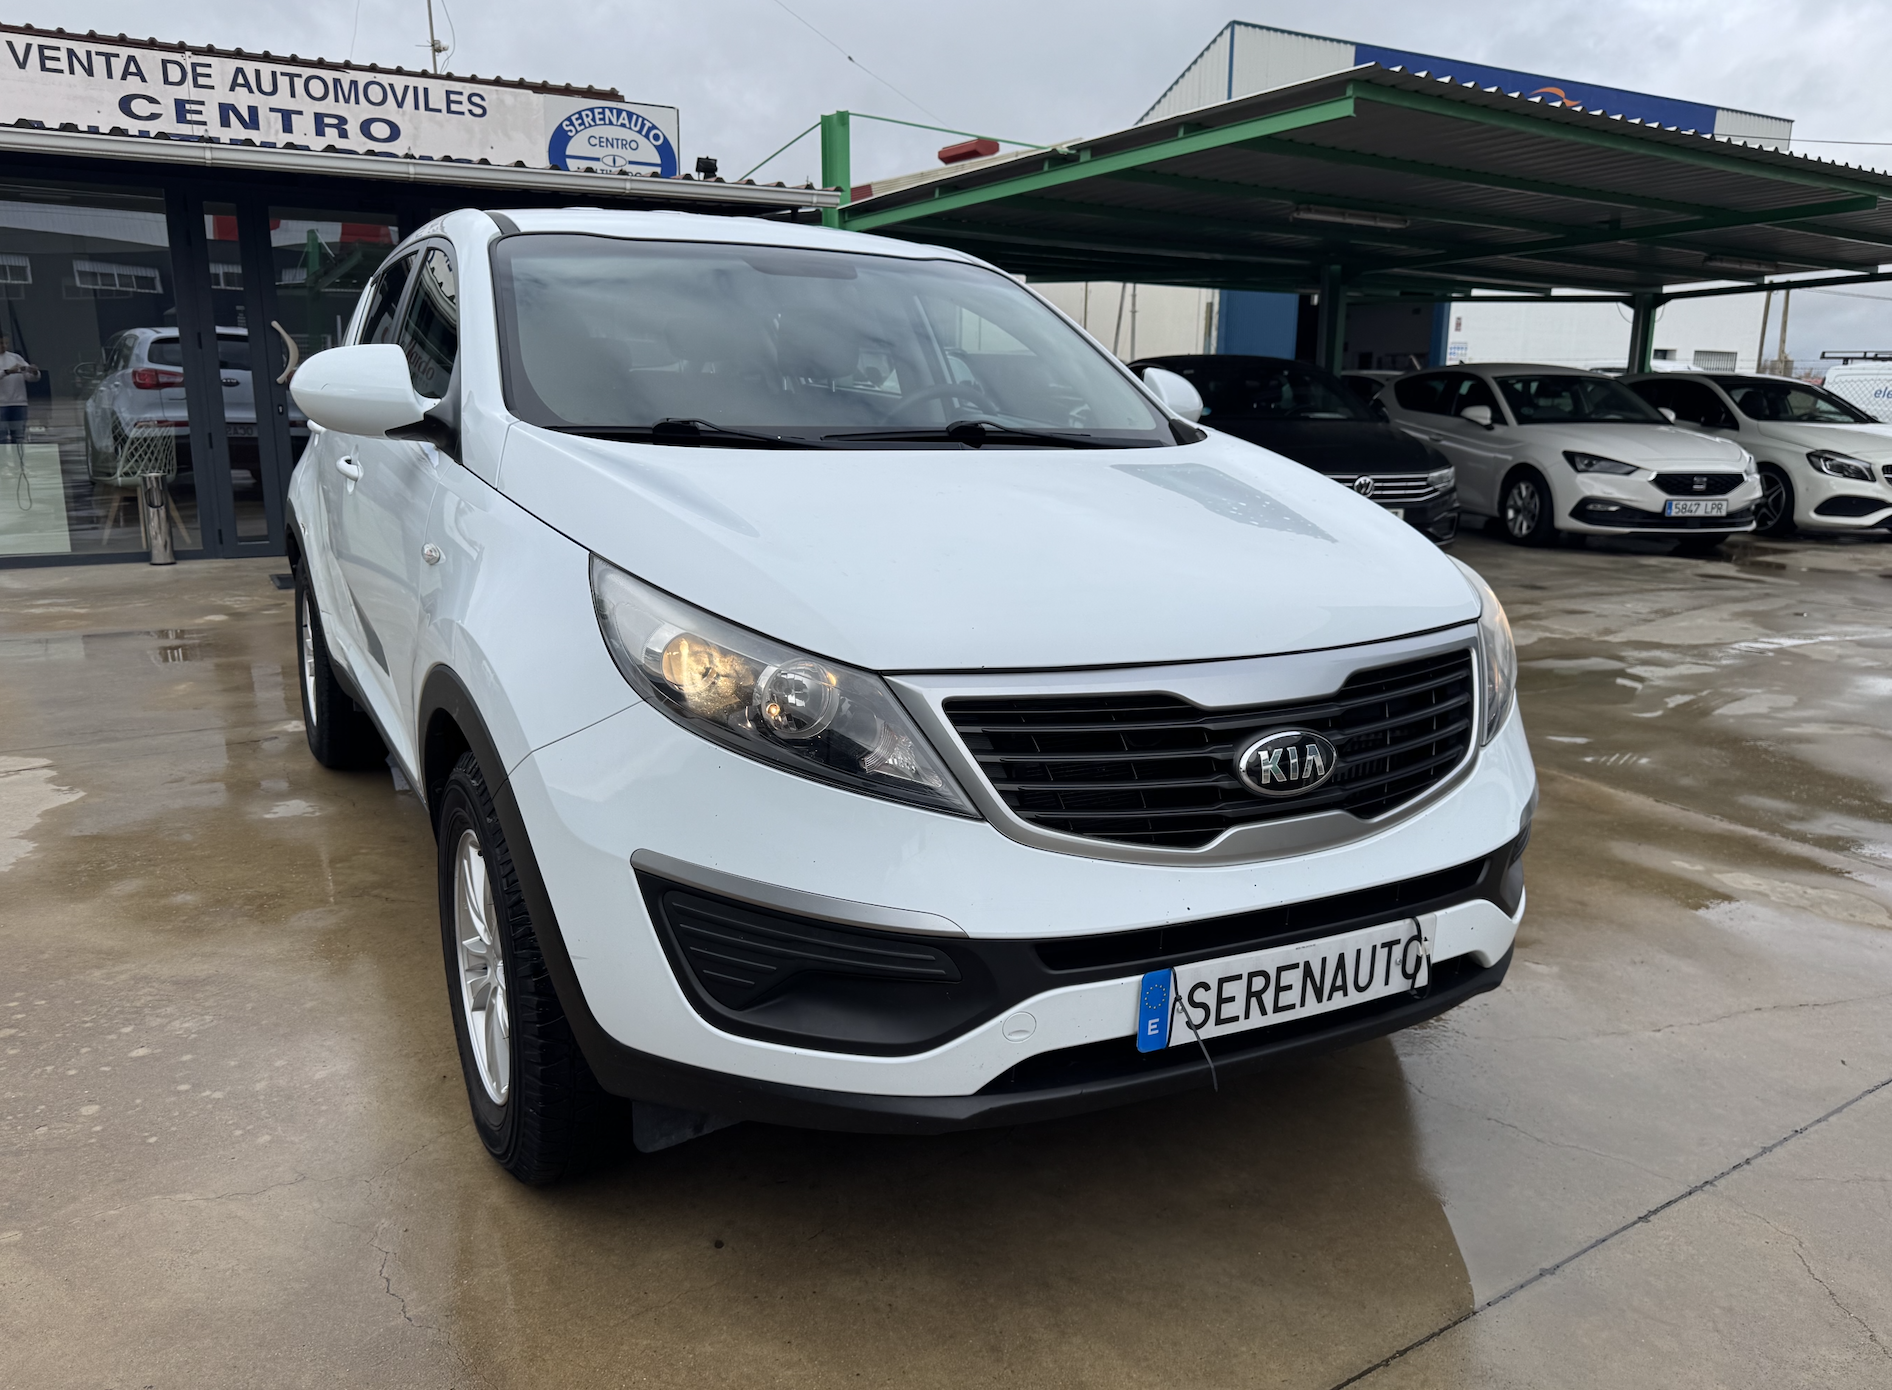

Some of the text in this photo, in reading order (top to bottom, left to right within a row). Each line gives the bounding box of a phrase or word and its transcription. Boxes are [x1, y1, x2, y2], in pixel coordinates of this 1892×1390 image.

[6, 40, 487, 118] VENTA DE AUTOMOVILES
[118, 93, 402, 143] CENTRO
[562, 108, 664, 146] SERENAUTO
[588, 135, 639, 151] CENTRO
[1674, 503, 1723, 515] 5847 LPR
[1258, 744, 1325, 784] KIA
[1186, 934, 1423, 1031] SERENAUTO
[1147, 1018, 1160, 1036] E
